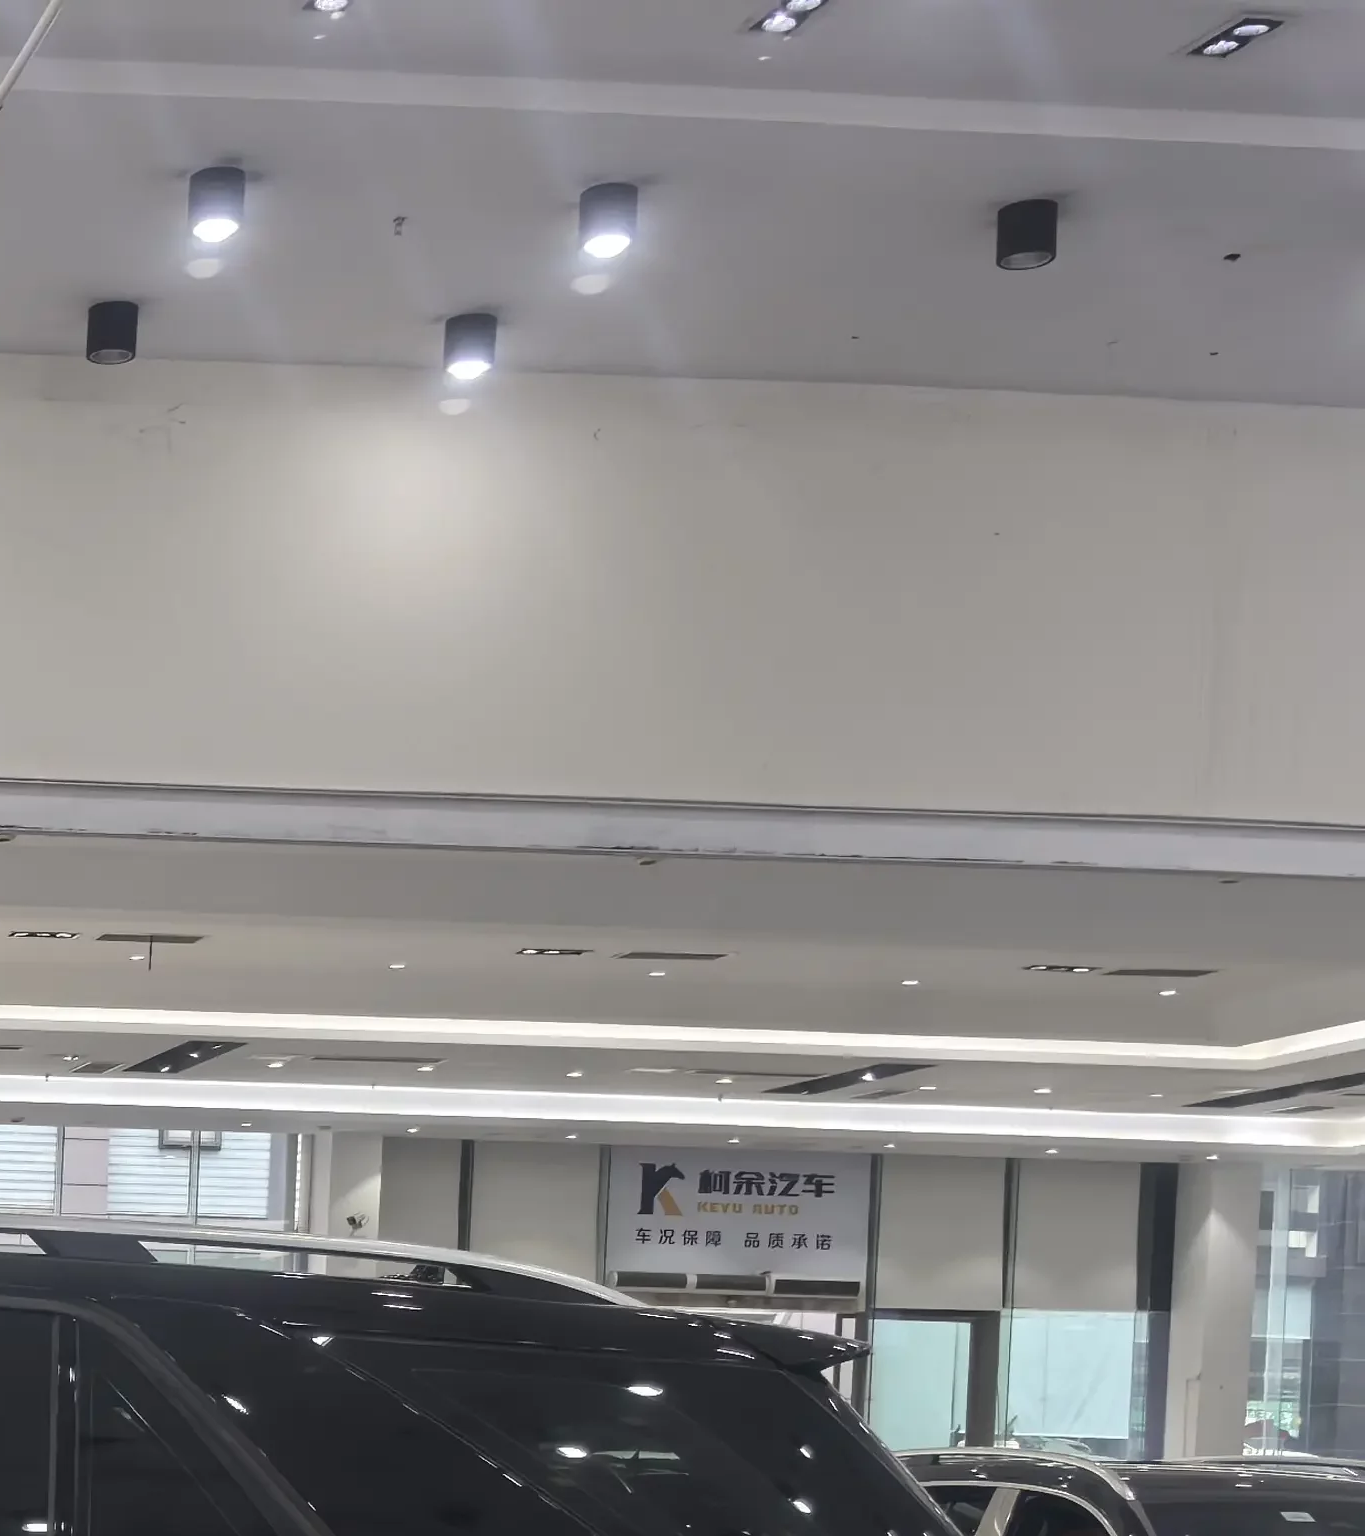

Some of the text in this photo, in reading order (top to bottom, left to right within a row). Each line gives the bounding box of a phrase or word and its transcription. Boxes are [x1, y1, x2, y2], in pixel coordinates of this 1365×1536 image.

[697, 1169, 836, 1198] 柯余汽车
[697, 1201, 800, 1217] KEYU AUTO
[635, 1227, 834, 1251] 车况保障 品质承诺
